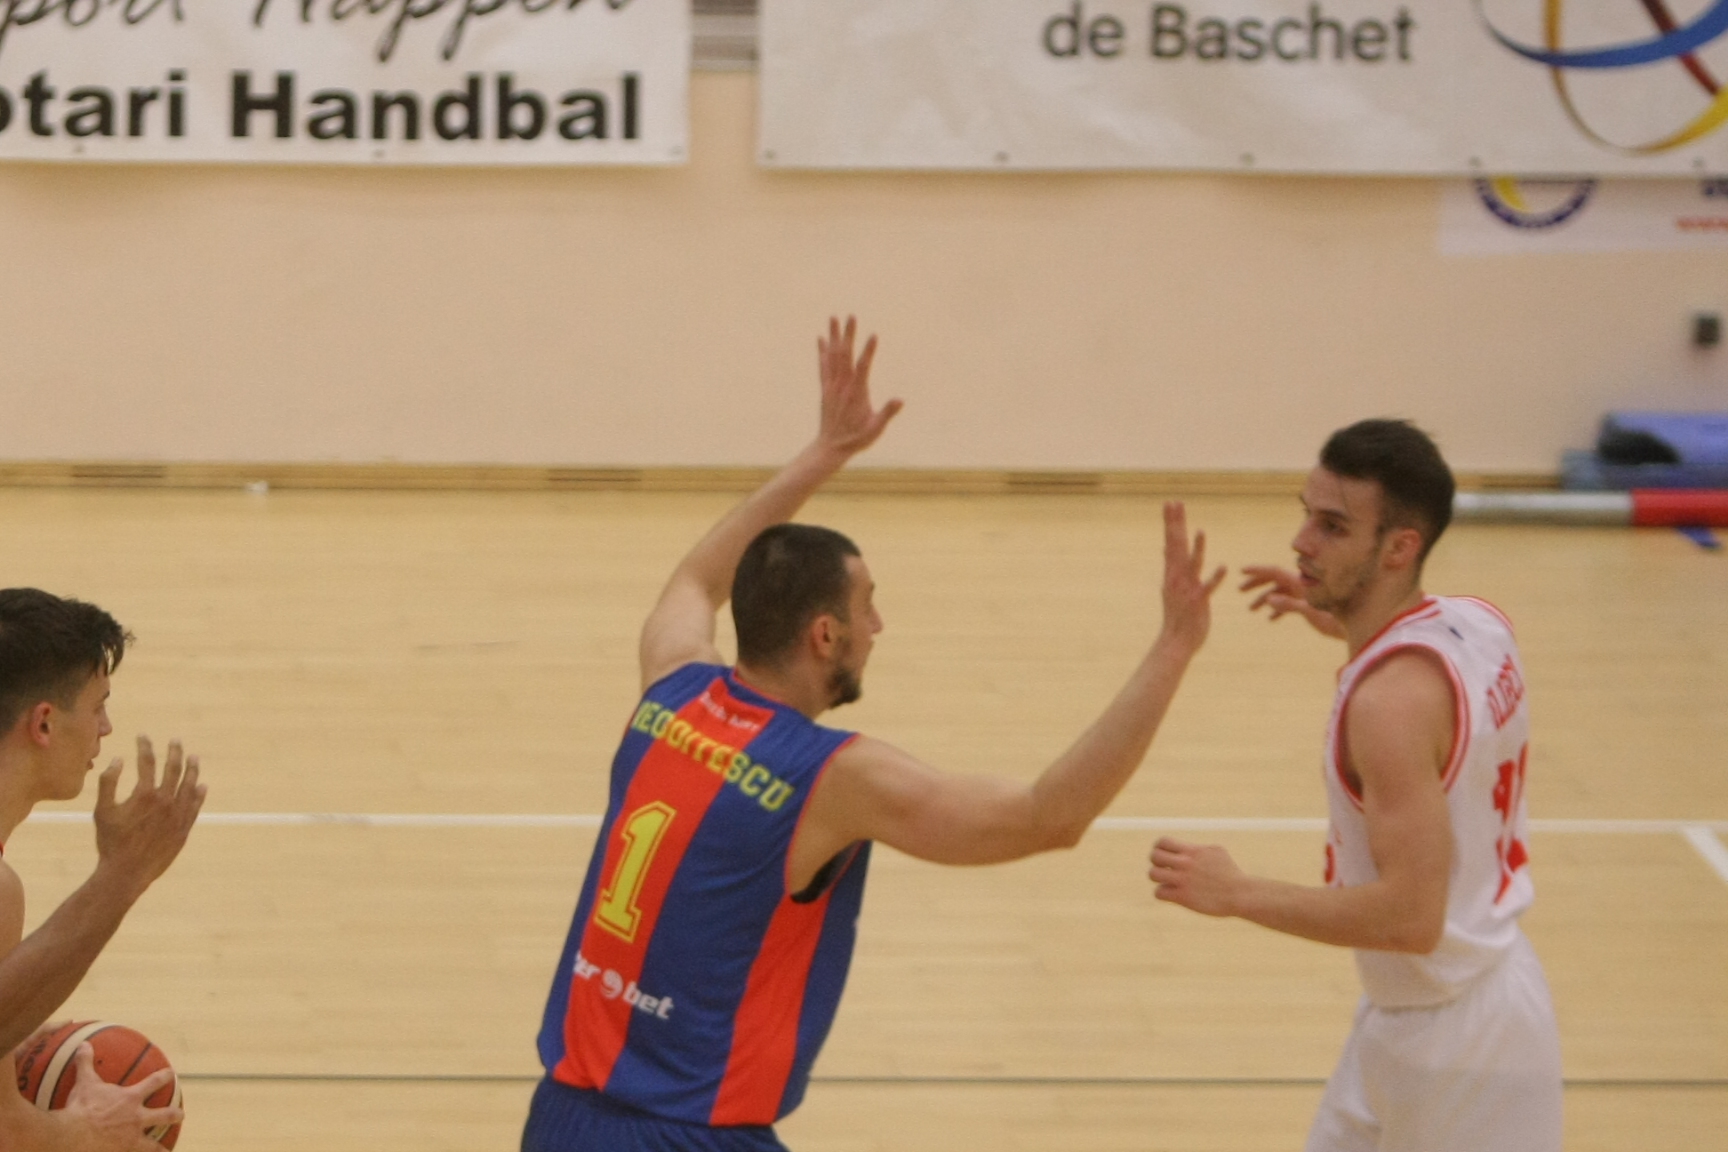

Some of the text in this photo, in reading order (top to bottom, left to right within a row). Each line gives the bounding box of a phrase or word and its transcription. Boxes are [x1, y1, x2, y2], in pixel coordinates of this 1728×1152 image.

[1043, 0, 1414, 62] de Baschet
[230, 71, 640, 141] Handbal
[593, 800, 676, 944] 1
